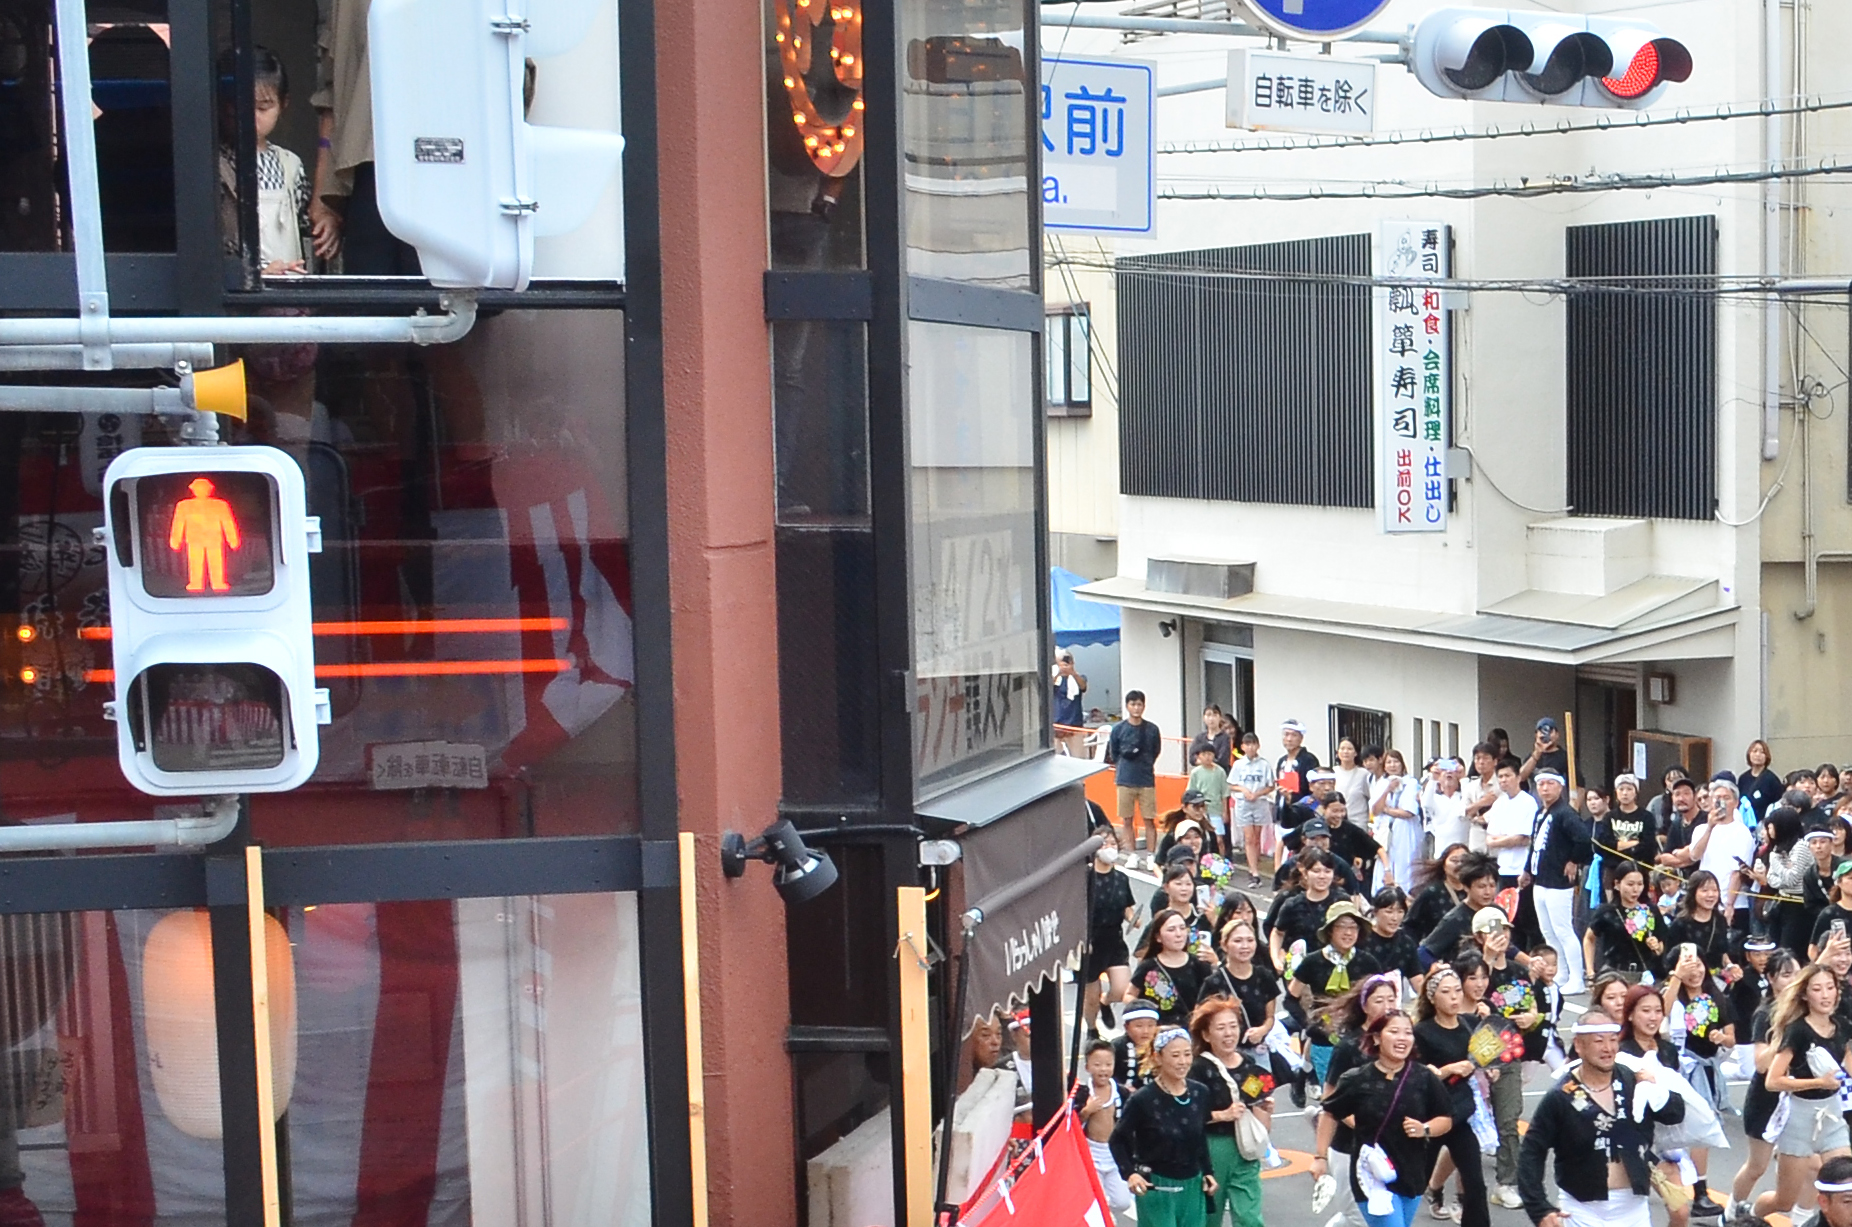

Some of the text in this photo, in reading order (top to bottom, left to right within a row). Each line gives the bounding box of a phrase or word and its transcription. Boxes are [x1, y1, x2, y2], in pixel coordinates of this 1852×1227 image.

[1255, 73, 1368, 115] 自転車を除く
[1004, 910, 1060, 976] いらっしゃいませ
